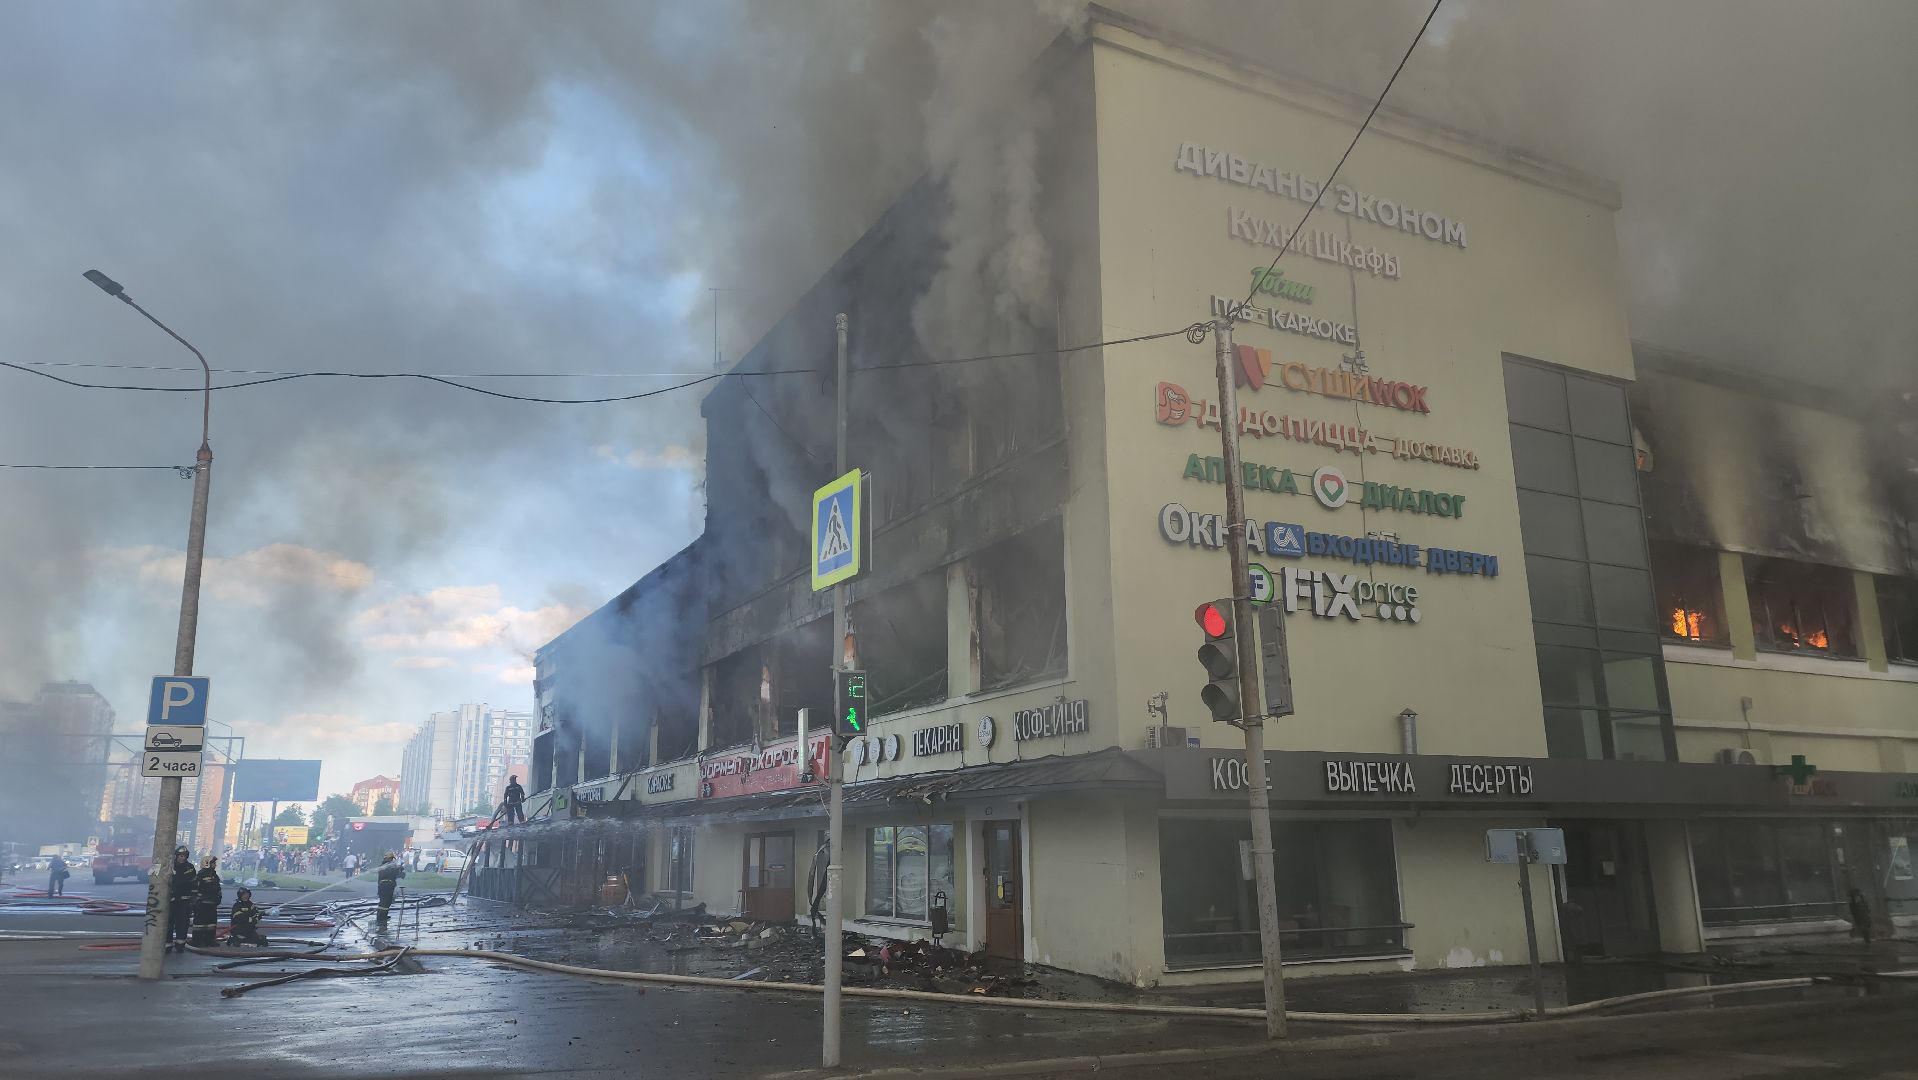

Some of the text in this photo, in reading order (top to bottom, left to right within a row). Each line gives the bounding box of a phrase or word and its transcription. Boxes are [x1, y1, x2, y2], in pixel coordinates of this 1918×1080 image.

[1175, 143, 1468, 248] ДИВАНЫ ЭКОНОМ
[1268, 307, 1357, 346] КАРАОКЕ
[1197, 399, 1481, 470] ДДОПИЦЦА ДОСТАВКА
[1182, 453, 1466, 519] АПЕКА ДИАЛОГ
[1306, 531, 1500, 578] ВХОДНЫЕ ДВЕРИ
[161, 681, 195, 720] P
[1013, 700, 1089, 741] КОФЕЙНЯ
[912, 723, 964, 757] ПЕКАРНЯ
[149, 756, 196, 771] 2 часа
[1327, 761, 1416, 793] ВЫПЕЧКА
[1450, 764, 1534, 794] ДЕСЕРТЫ
